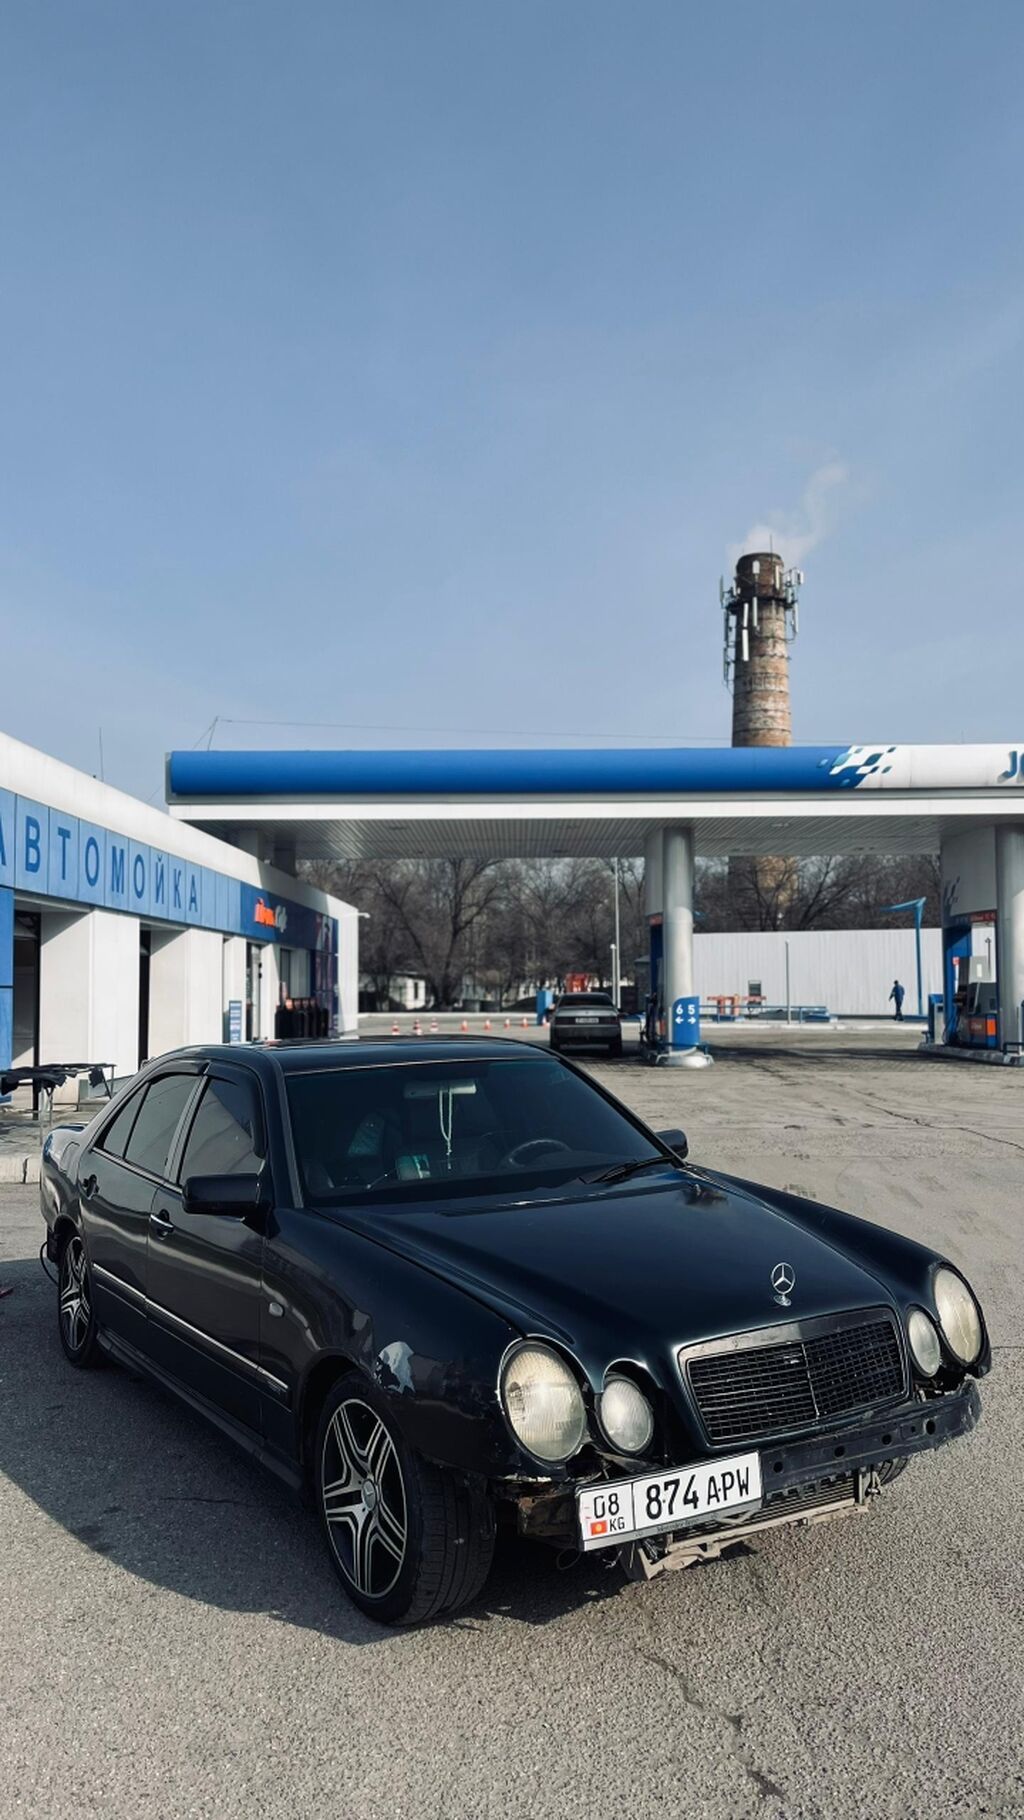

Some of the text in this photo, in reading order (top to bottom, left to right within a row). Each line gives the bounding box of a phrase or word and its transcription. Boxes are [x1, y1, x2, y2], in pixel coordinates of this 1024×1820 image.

[676, 1004, 695, 1015] 6 5
[593, 1466, 749, 1520] 08 874 APW
[609, 1516, 625, 1532] KG
